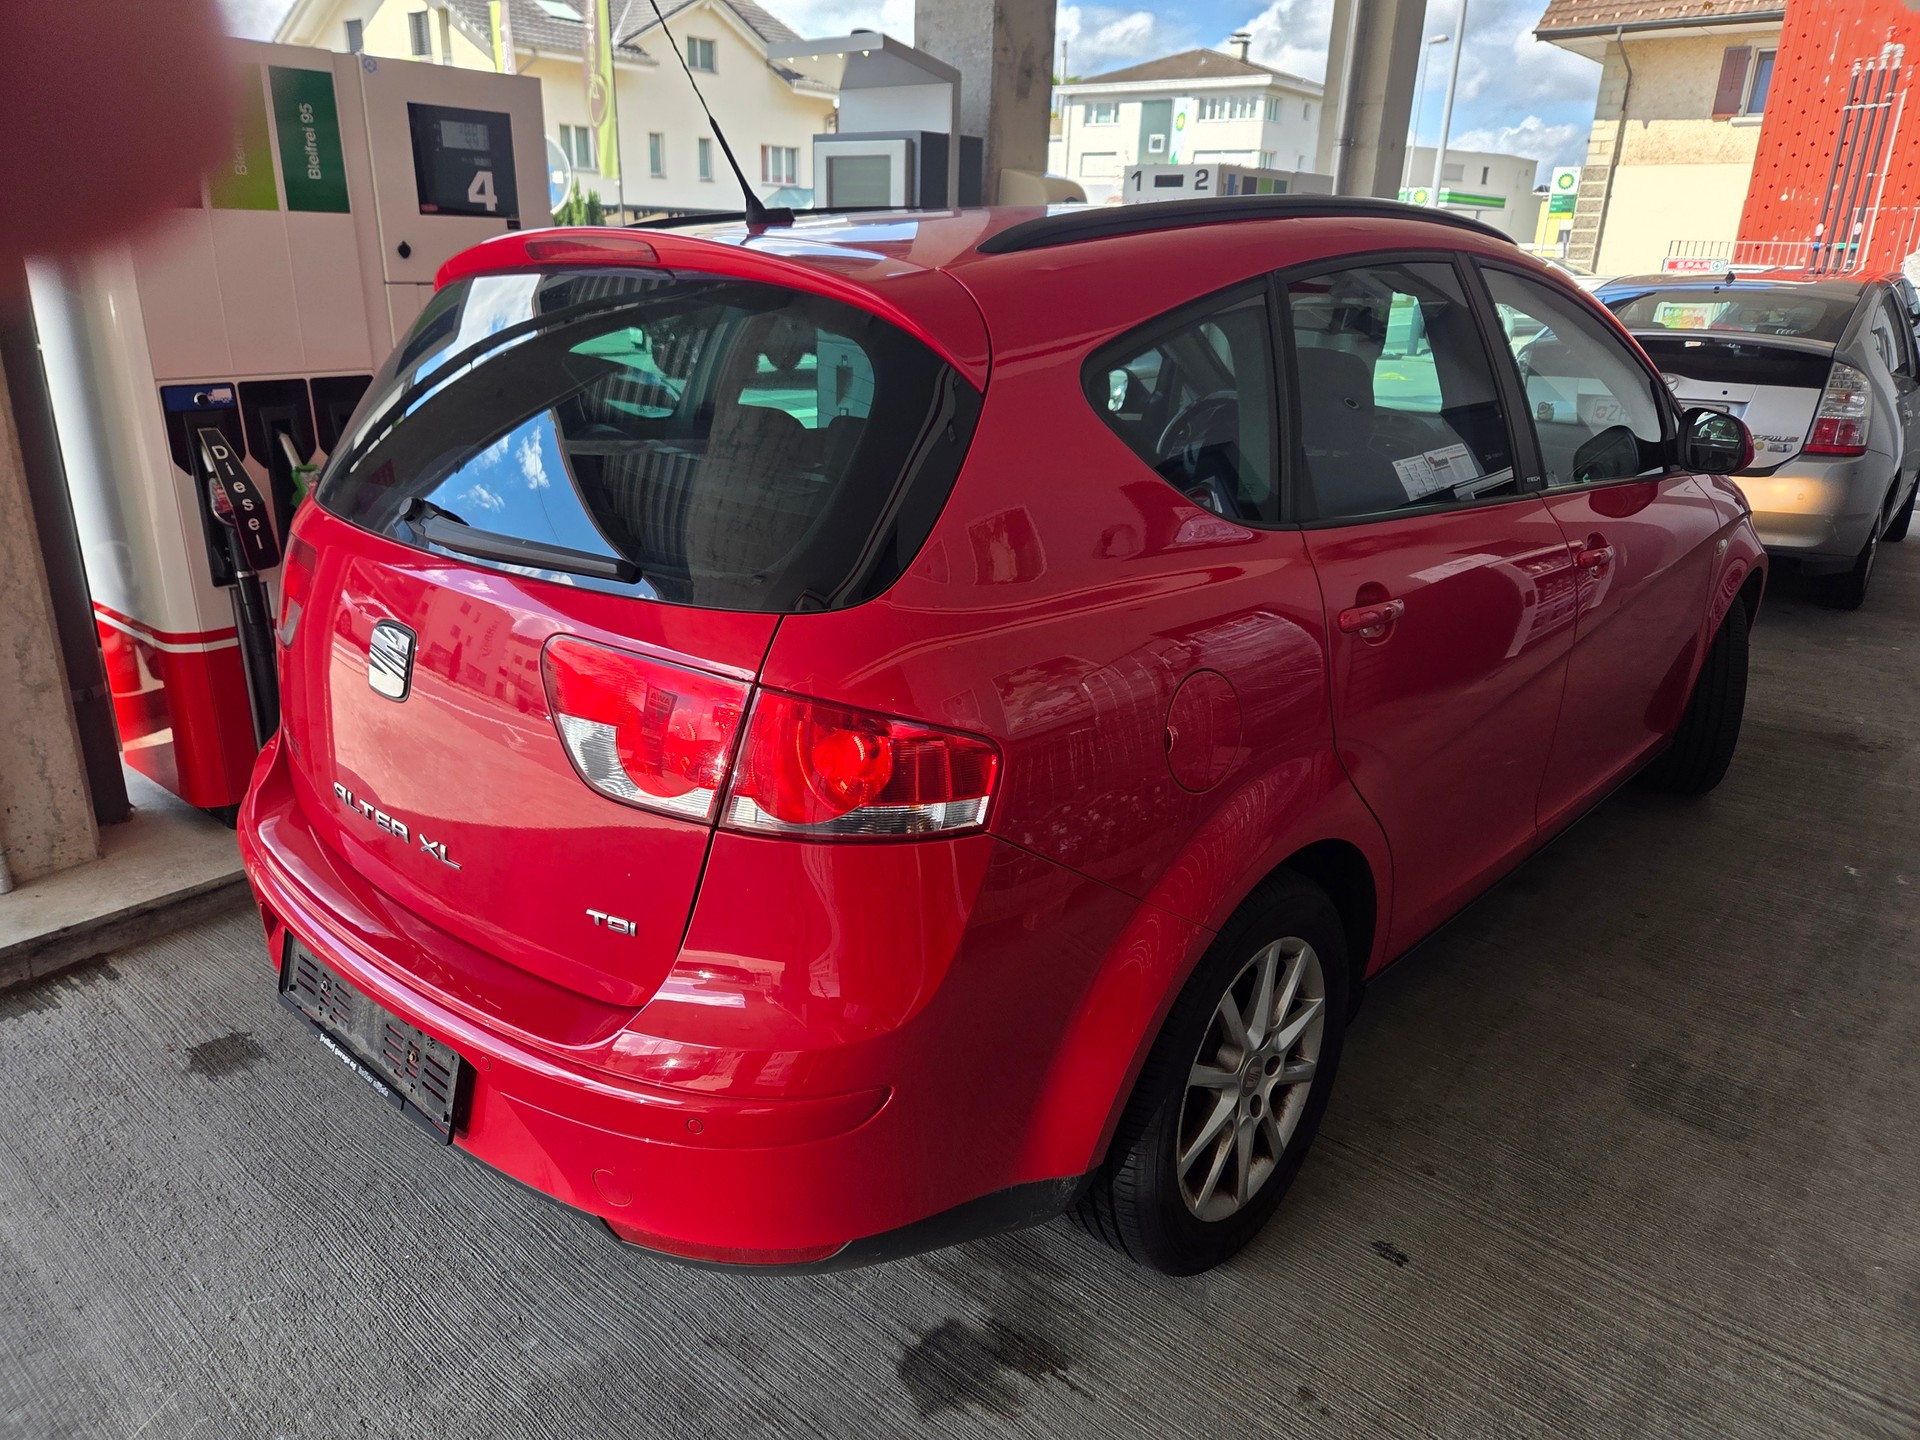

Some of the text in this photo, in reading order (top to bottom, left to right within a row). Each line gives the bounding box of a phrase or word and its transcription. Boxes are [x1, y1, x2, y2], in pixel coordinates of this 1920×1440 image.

[299, 103, 322, 180] Bleifrei 95
[468, 170, 498, 212] 4
[1131, 170, 1142, 192] 1
[1194, 168, 1209, 191] 2
[1676, 260, 1711, 270] SPAR
[211, 445, 264, 550] Diesel
[333, 781, 462, 870] ALTEA XL
[586, 908, 638, 937] TDI
